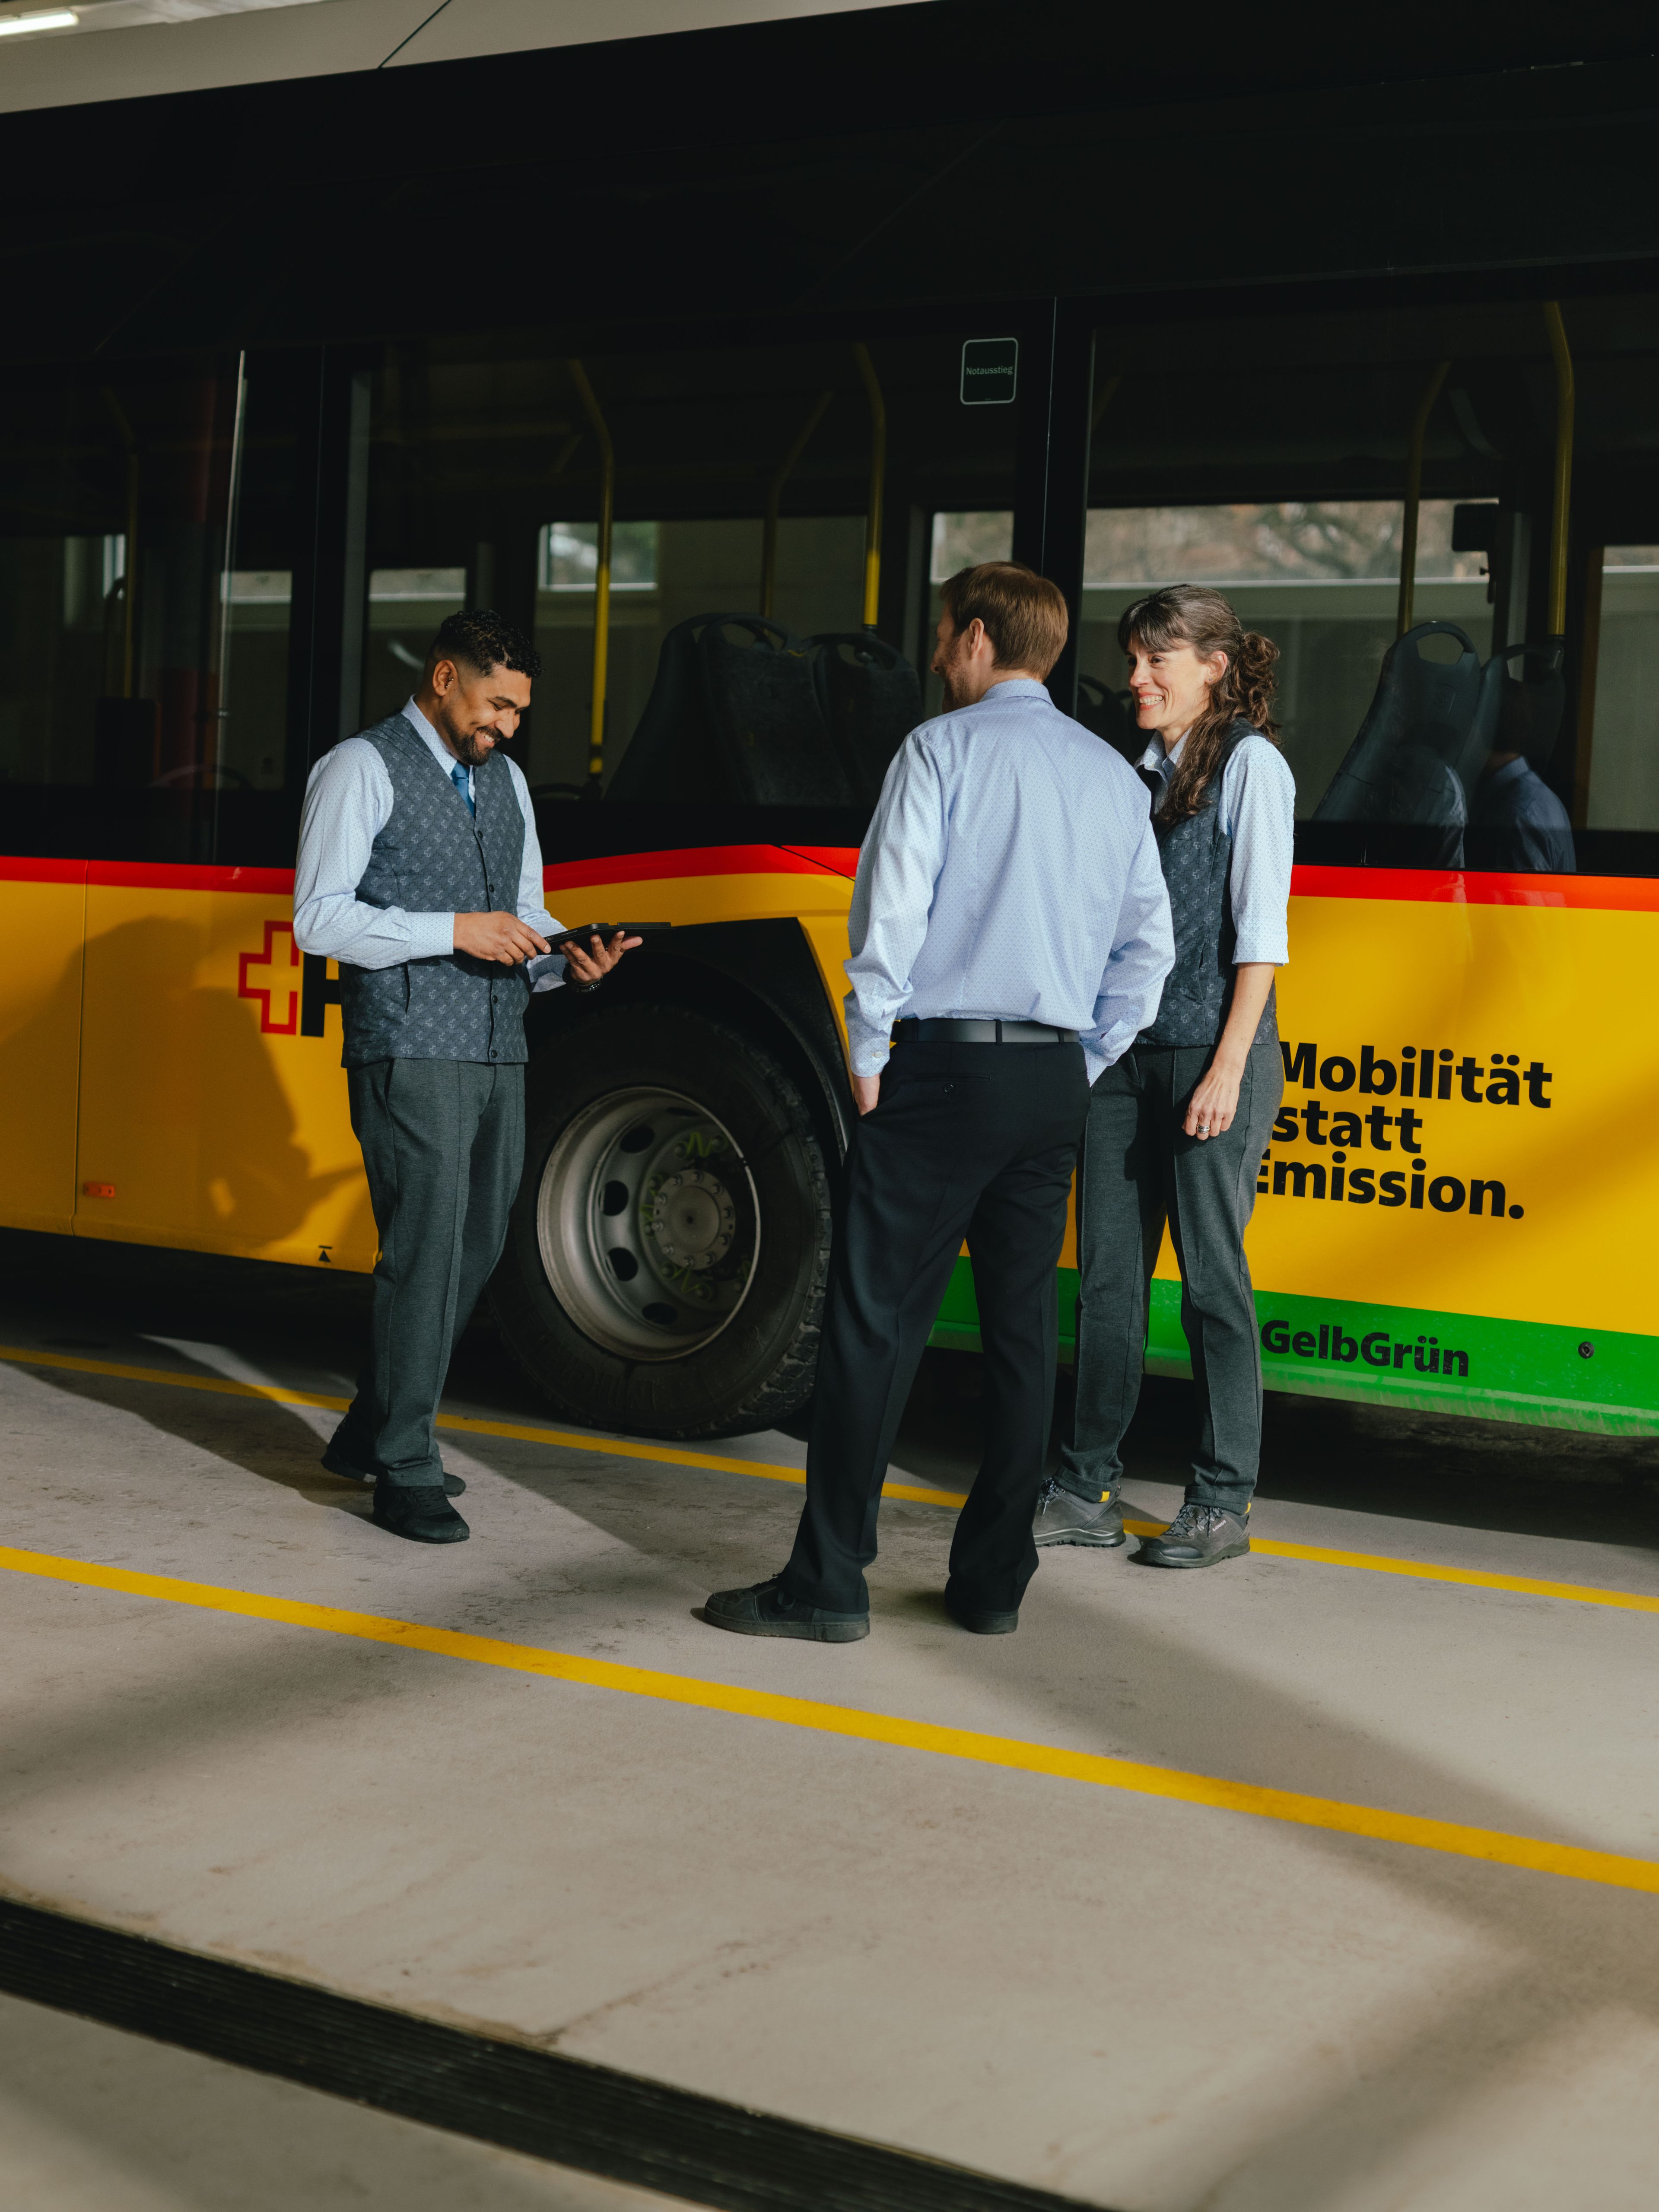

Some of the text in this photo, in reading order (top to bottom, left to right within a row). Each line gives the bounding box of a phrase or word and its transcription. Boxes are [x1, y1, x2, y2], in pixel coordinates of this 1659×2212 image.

[966, 365, 1014, 375] Notausstieg
[1279, 1041, 1552, 1108] Mobilität
[1271, 1100, 1423, 1154] statt
[1258, 1320, 1469, 1377] GelbGrün
[1212, 1520, 1226, 1532] LOWA
